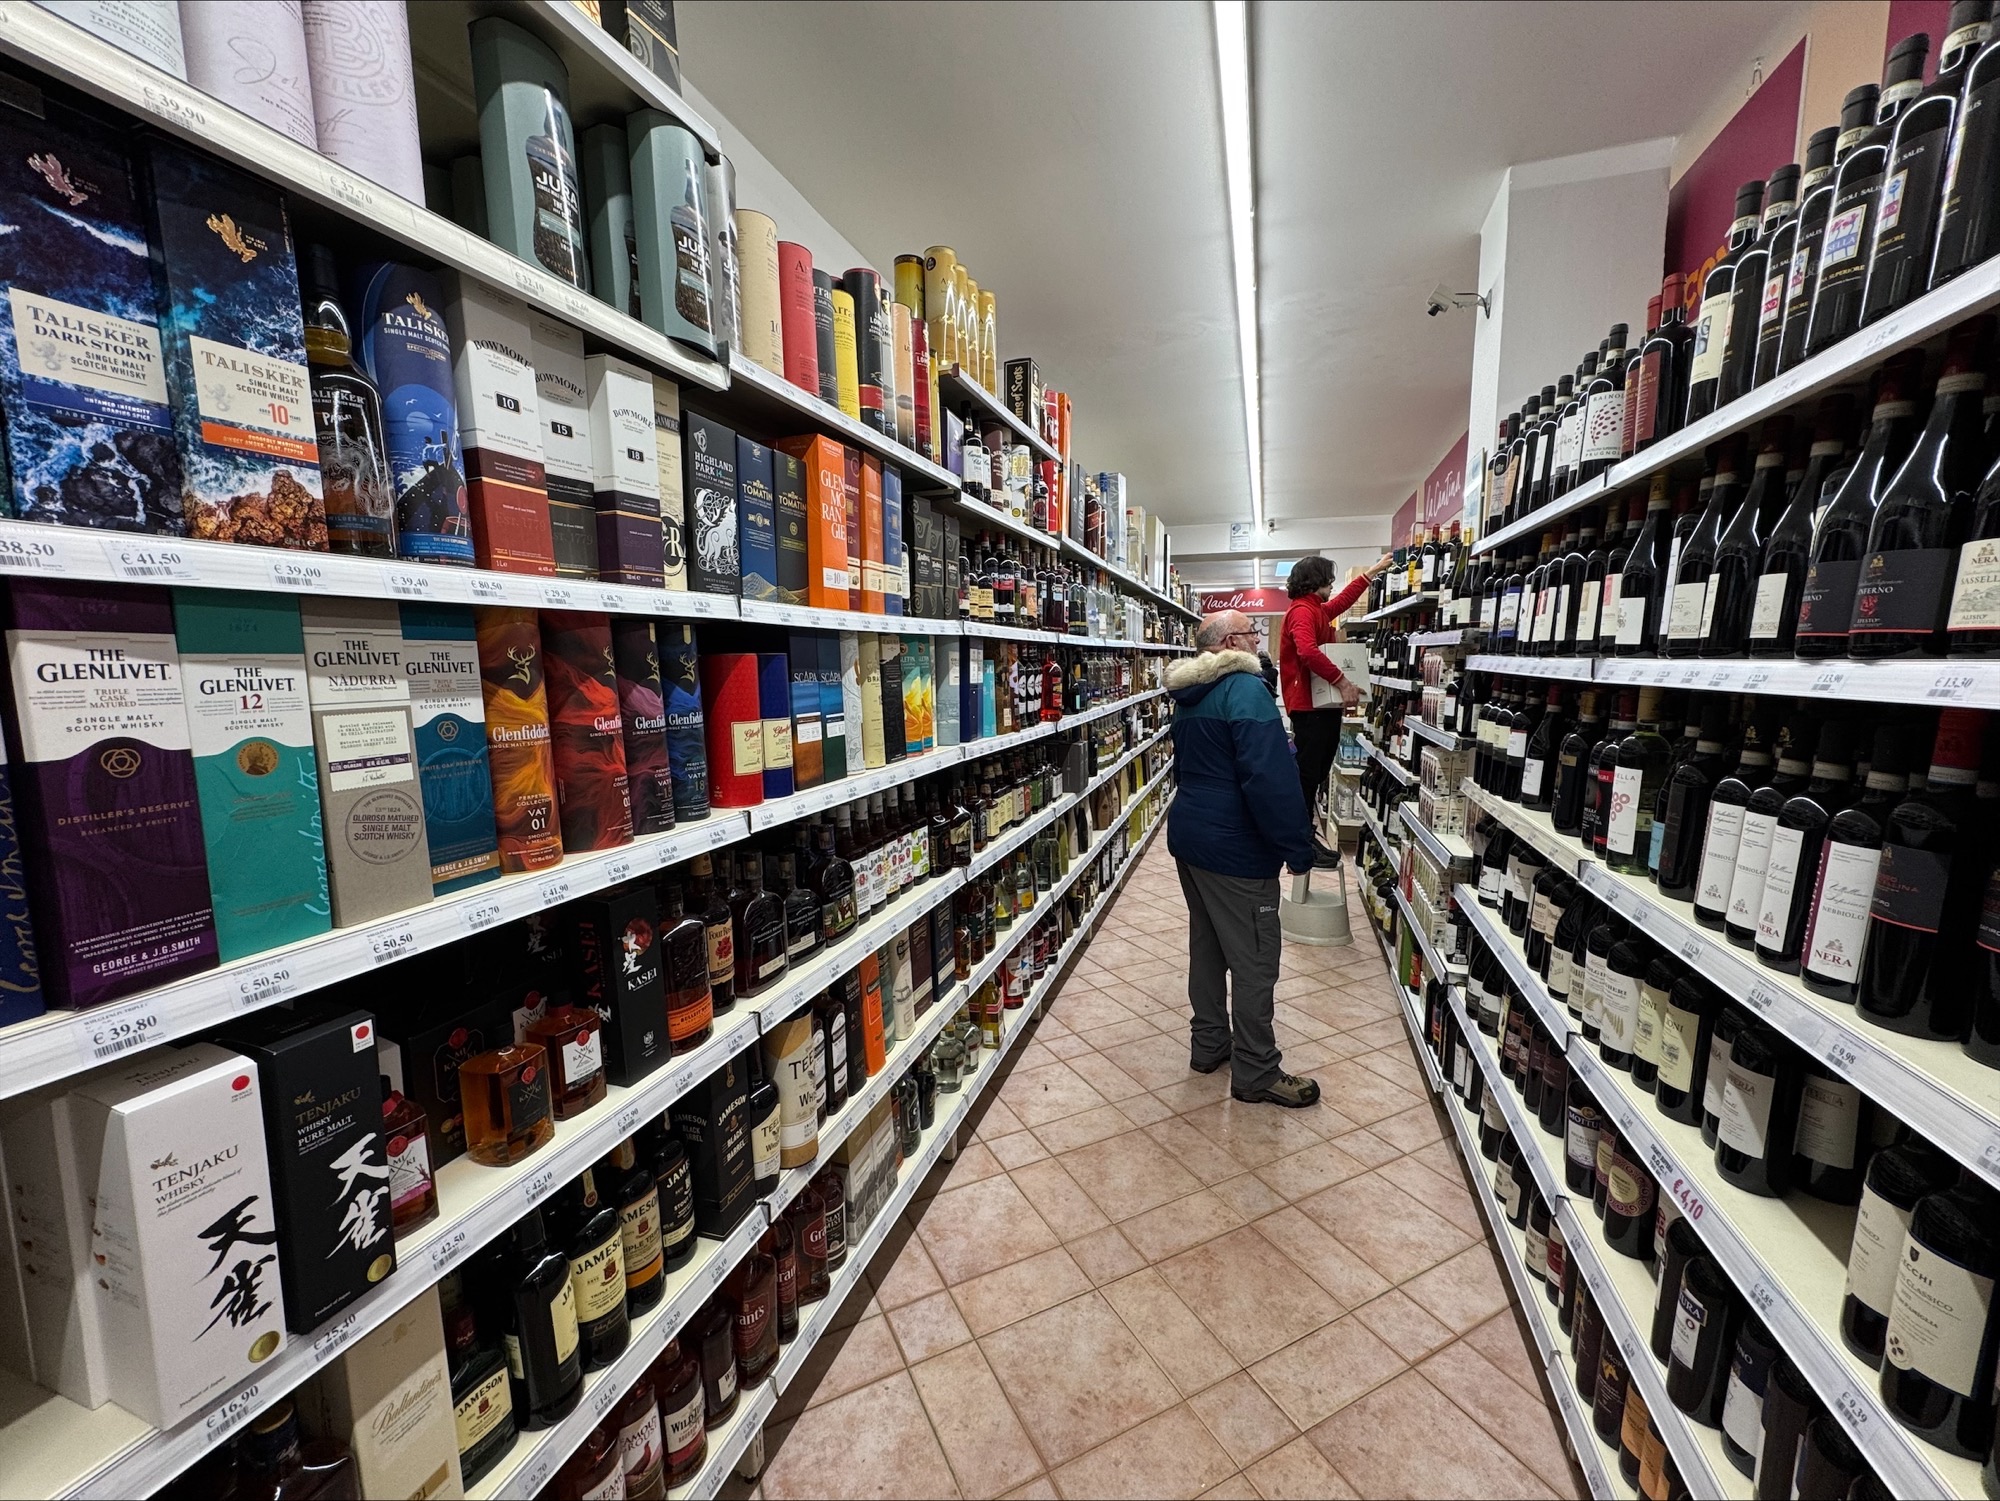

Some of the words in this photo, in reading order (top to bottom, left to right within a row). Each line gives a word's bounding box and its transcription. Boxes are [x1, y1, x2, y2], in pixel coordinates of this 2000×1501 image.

[143, 86, 157, 100] €
[160, 92, 206, 126] 39,90
[330, 176, 337, 186] €
[536, 170, 578, 207] JURA
[678, 234, 711, 264] JURA
[515, 271, 522, 281] €
[26, 304, 152, 351] TALISKER
[34, 325, 89, 348] DARK
[90, 339, 153, 364] STORM
[85, 351, 119, 366] SINGLE
[121, 360, 145, 373] MALT
[474, 339, 532, 371] BOWMORE
[70, 356, 109, 371] SCOTCH
[110, 366, 147, 381] WHISKY
[201, 350, 304, 389] TALISKER
[236, 384, 267, 398] SCOTCH
[269, 392, 300, 406] WHISKY
[248, 378, 277, 392] SINGLE
[279, 385, 299, 397] MALT
[1593, 392, 1625, 402] RAINOL
[503, 397, 515, 410] 10
[267, 402, 290, 426] 10
[612, 408, 654, 430] BOWMORE
[557, 425, 568, 436] 15
[631, 450, 641, 460] 18
[694, 450, 734, 474] HIGHLAND
[1586, 450, 1621, 458] PRUGNOL
[695, 462, 716, 476] PARK
[820, 469, 845, 493] GLEN
[742, 483, 773, 502] TOMATIN
[830, 490, 846, 510] MO
[778, 494, 807, 512] TOMATIN
[821, 505, 842, 524] RAN
[831, 523, 846, 541] GIE
[120, 552, 134, 565] €
[136, 552, 182, 567] 41,50
[1971, 556, 1998, 565] NERA
[273, 563, 283, 575] €
[284, 564, 322, 579] 39,00
[833, 572, 841, 584] 10
[1960, 574, 2000, 586] SASSELL
[391, 575, 399, 586] €
[400, 577, 429, 588] 39,40
[471, 579, 478, 590] €
[477, 579, 503, 591] 80,50
[1201, 592, 1265, 611] Macelleria
[85, 647, 126, 662] THE
[343, 639, 369, 652] THE
[313, 651, 400, 668] GLENLIVET
[430, 651, 451, 661] THE
[36, 662, 171, 684] GLENLIVET
[234, 667, 262, 679] THE
[406, 660, 475, 675] GLENLIVET
[820, 671, 843, 683] SCAPA
[199, 678, 296, 696] GLENLIVET
[793, 671, 818, 684] SCAPA
[1935, 677, 1942, 687] €
[1943, 677, 1974, 688] 13,30
[93, 688, 129, 697] TRIPLE
[89, 700, 137, 709] MATURED
[239, 693, 264, 712] 12
[65, 723, 115, 733] SCOTCH
[120, 721, 165, 730] WHISKY
[75, 715, 121, 724] SINGLE
[126, 713, 155, 722] MALT
[57, 807, 135, 827] DISTILLER'S
[139, 800, 191, 816] RESERVE
[353, 814, 387, 822] OLOROSO
[387, 814, 419, 822] MATURED
[528, 807, 548, 818] VAT
[361, 823, 391, 832] SINGLE
[391, 823, 412, 832] MALT
[530, 817, 546, 831] 01
[353, 832, 386, 841] SCOTCH
[386, 831, 416, 841] WHISKY
[542, 889, 549, 899] €
[548, 883, 570, 896] 41,90
[468, 912, 475, 923] €
[476, 905, 500, 920] 57,70
[1822, 906, 1866, 921] NEBBIOLO
[373, 943, 381, 955] €
[383, 932, 414, 952] 50,50
[93, 954, 138, 975] GEORGE
[141, 952, 149, 960] &
[152, 936, 202, 957] J.G.SMITH
[1814, 948, 1853, 968] NERA
[240, 981, 250, 994] €
[252, 969, 291, 989] 50,50
[627, 968, 659, 992] KASEI
[93, 1031, 106, 1046] €
[108, 1014, 158, 1042] 39,80
[1839, 1046, 1857, 1065] 9,98
[296, 1086, 362, 1126] TENJAKU
[623, 1107, 639, 1123] 37,90
[718, 1094, 747, 1127] JAMESON
[297, 1115, 333, 1136] WHISKY
[1568, 1112, 1601, 1130] MOTTU
[297, 1128, 326, 1147] PURE
[328, 1115, 354, 1135] MALT
[725, 1127, 744, 1149] BLACK
[725, 1140, 747, 1163] BARREL
[152, 1144, 240, 1194] TENJAKU
[532, 1171, 553, 1191] 42,10
[155, 1175, 207, 1207] WHISKY
[1673, 1178, 1684, 1195] €
[1679, 1189, 1705, 1222] 4,10
[432, 1249, 440, 1260] €
[441, 1231, 466, 1253] 42,50
[1906, 1278, 1954, 1313] CLASSICO
[314, 1340, 323, 1351] €
[324, 1313, 356, 1341] 25,40
[457, 1371, 506, 1418] JAMESON
[206, 1415, 218, 1429] €
[220, 1384, 260, 1417] 16,90
[1850, 1399, 1869, 1424] 9,39
